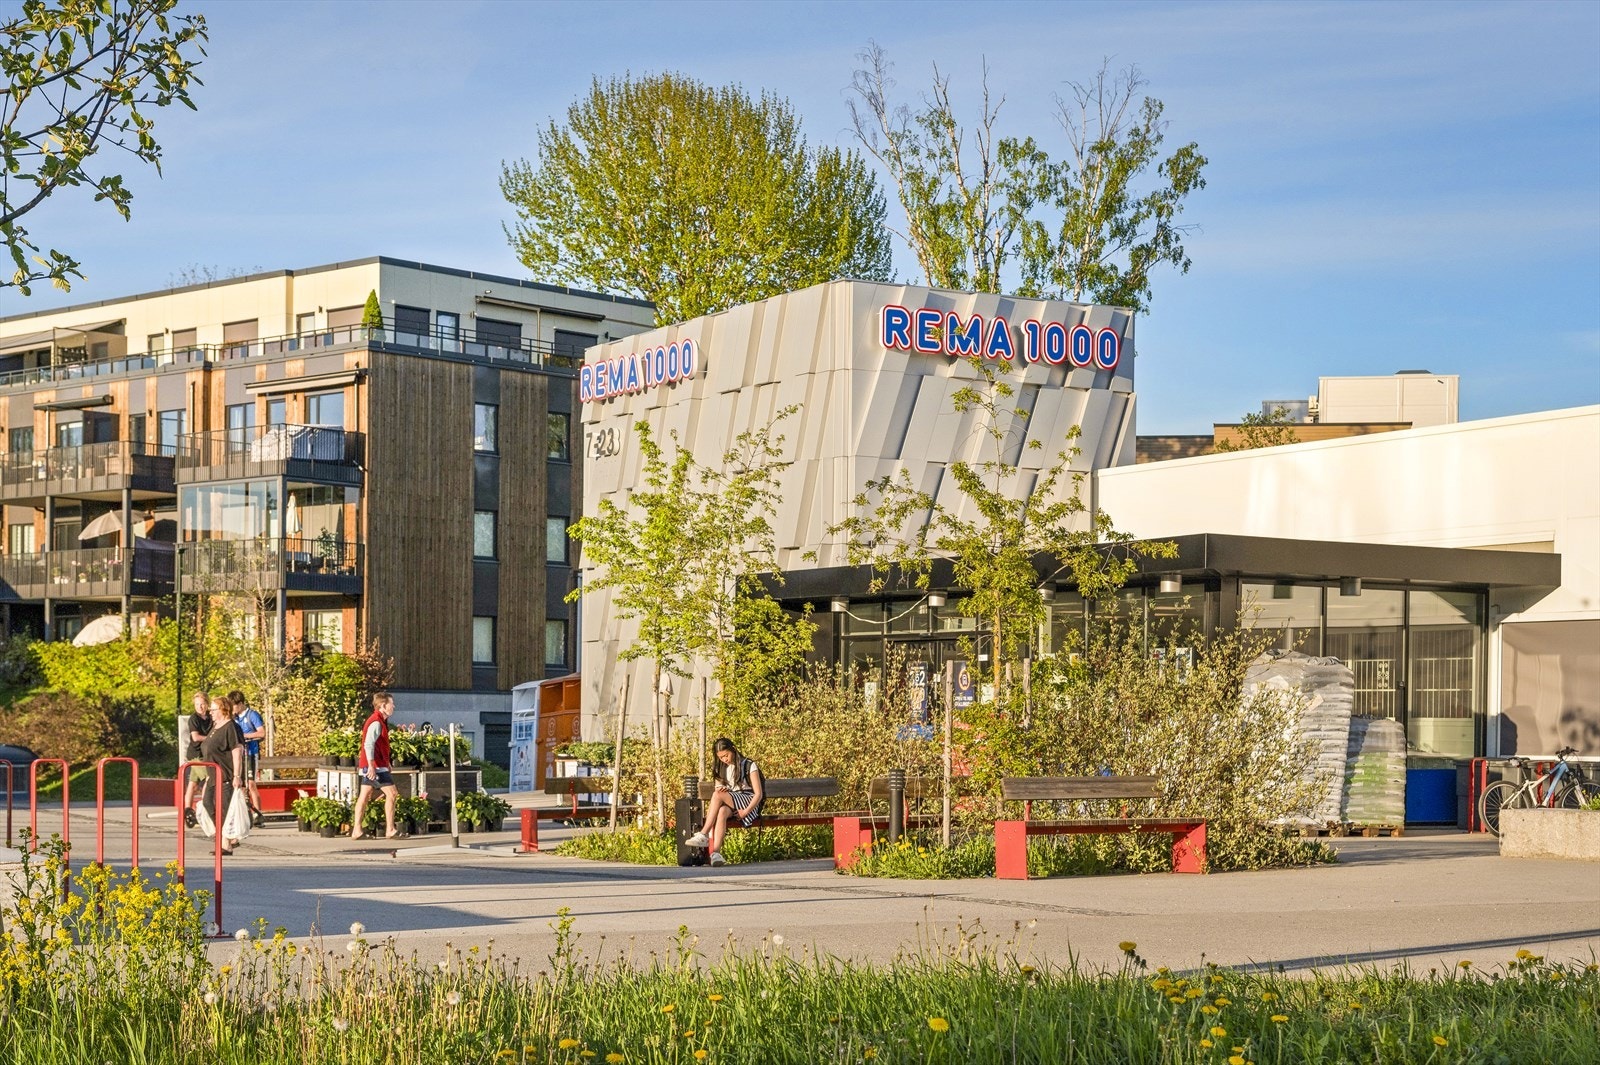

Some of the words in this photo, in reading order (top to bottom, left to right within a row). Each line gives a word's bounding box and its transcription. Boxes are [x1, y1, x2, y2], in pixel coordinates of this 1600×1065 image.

[882, 304, 1015, 360] REMA
[1024, 319, 1120, 370] 1000
[579, 353, 640, 402] REMA
[644, 338, 694, 387] 1000
